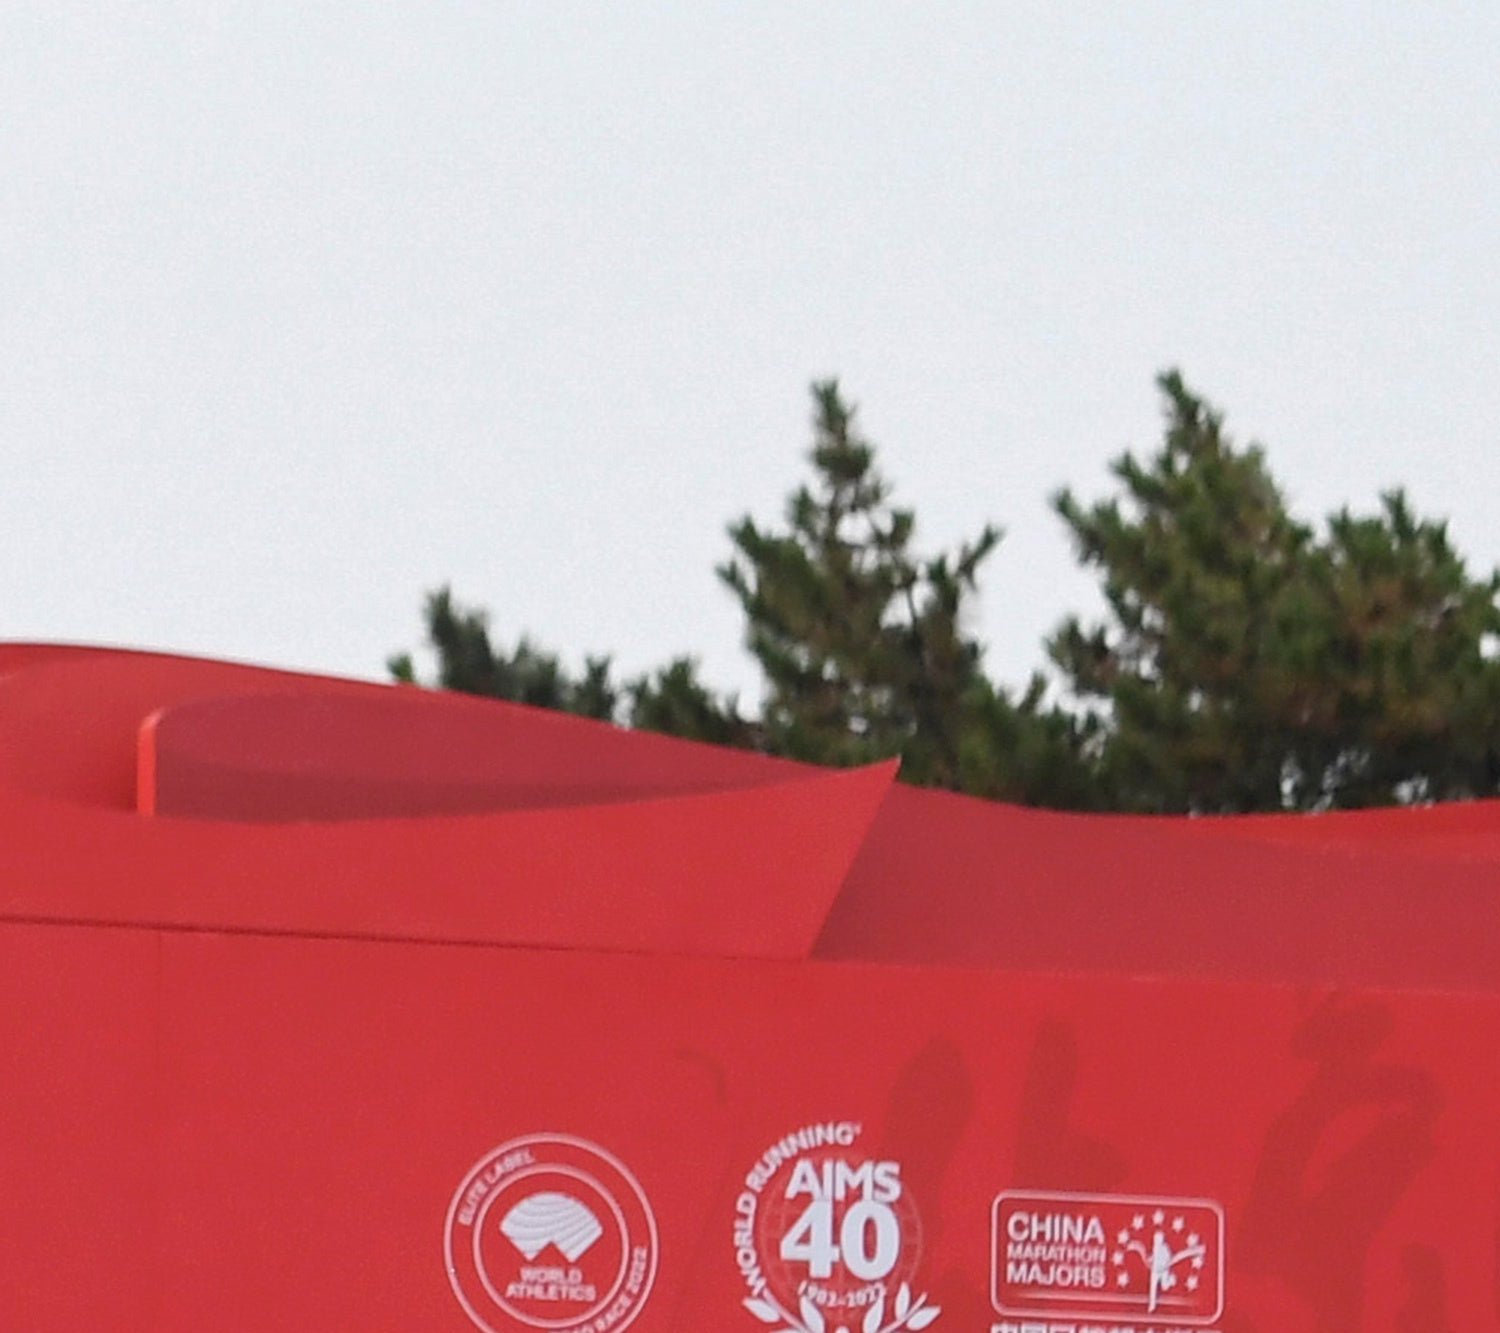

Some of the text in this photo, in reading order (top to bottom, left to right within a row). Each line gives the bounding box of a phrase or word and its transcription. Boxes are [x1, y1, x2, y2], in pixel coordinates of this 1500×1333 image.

[458, 1148, 536, 1226] ELITE LABEL
[784, 1158, 902, 1203] AIMS
[734, 1121, 855, 1296] WORLD RUNNING
[780, 1199, 900, 1280] 40
[1008, 1212, 1105, 1244] CHINA
[1007, 1242, 1106, 1263] MARATHON
[505, 1283, 597, 1301] ATHLETICS
[521, 1267, 582, 1284] WORLD
[1006, 1262, 1106, 1288] MAJORS
[595, 1293, 632, 1331] RACE
